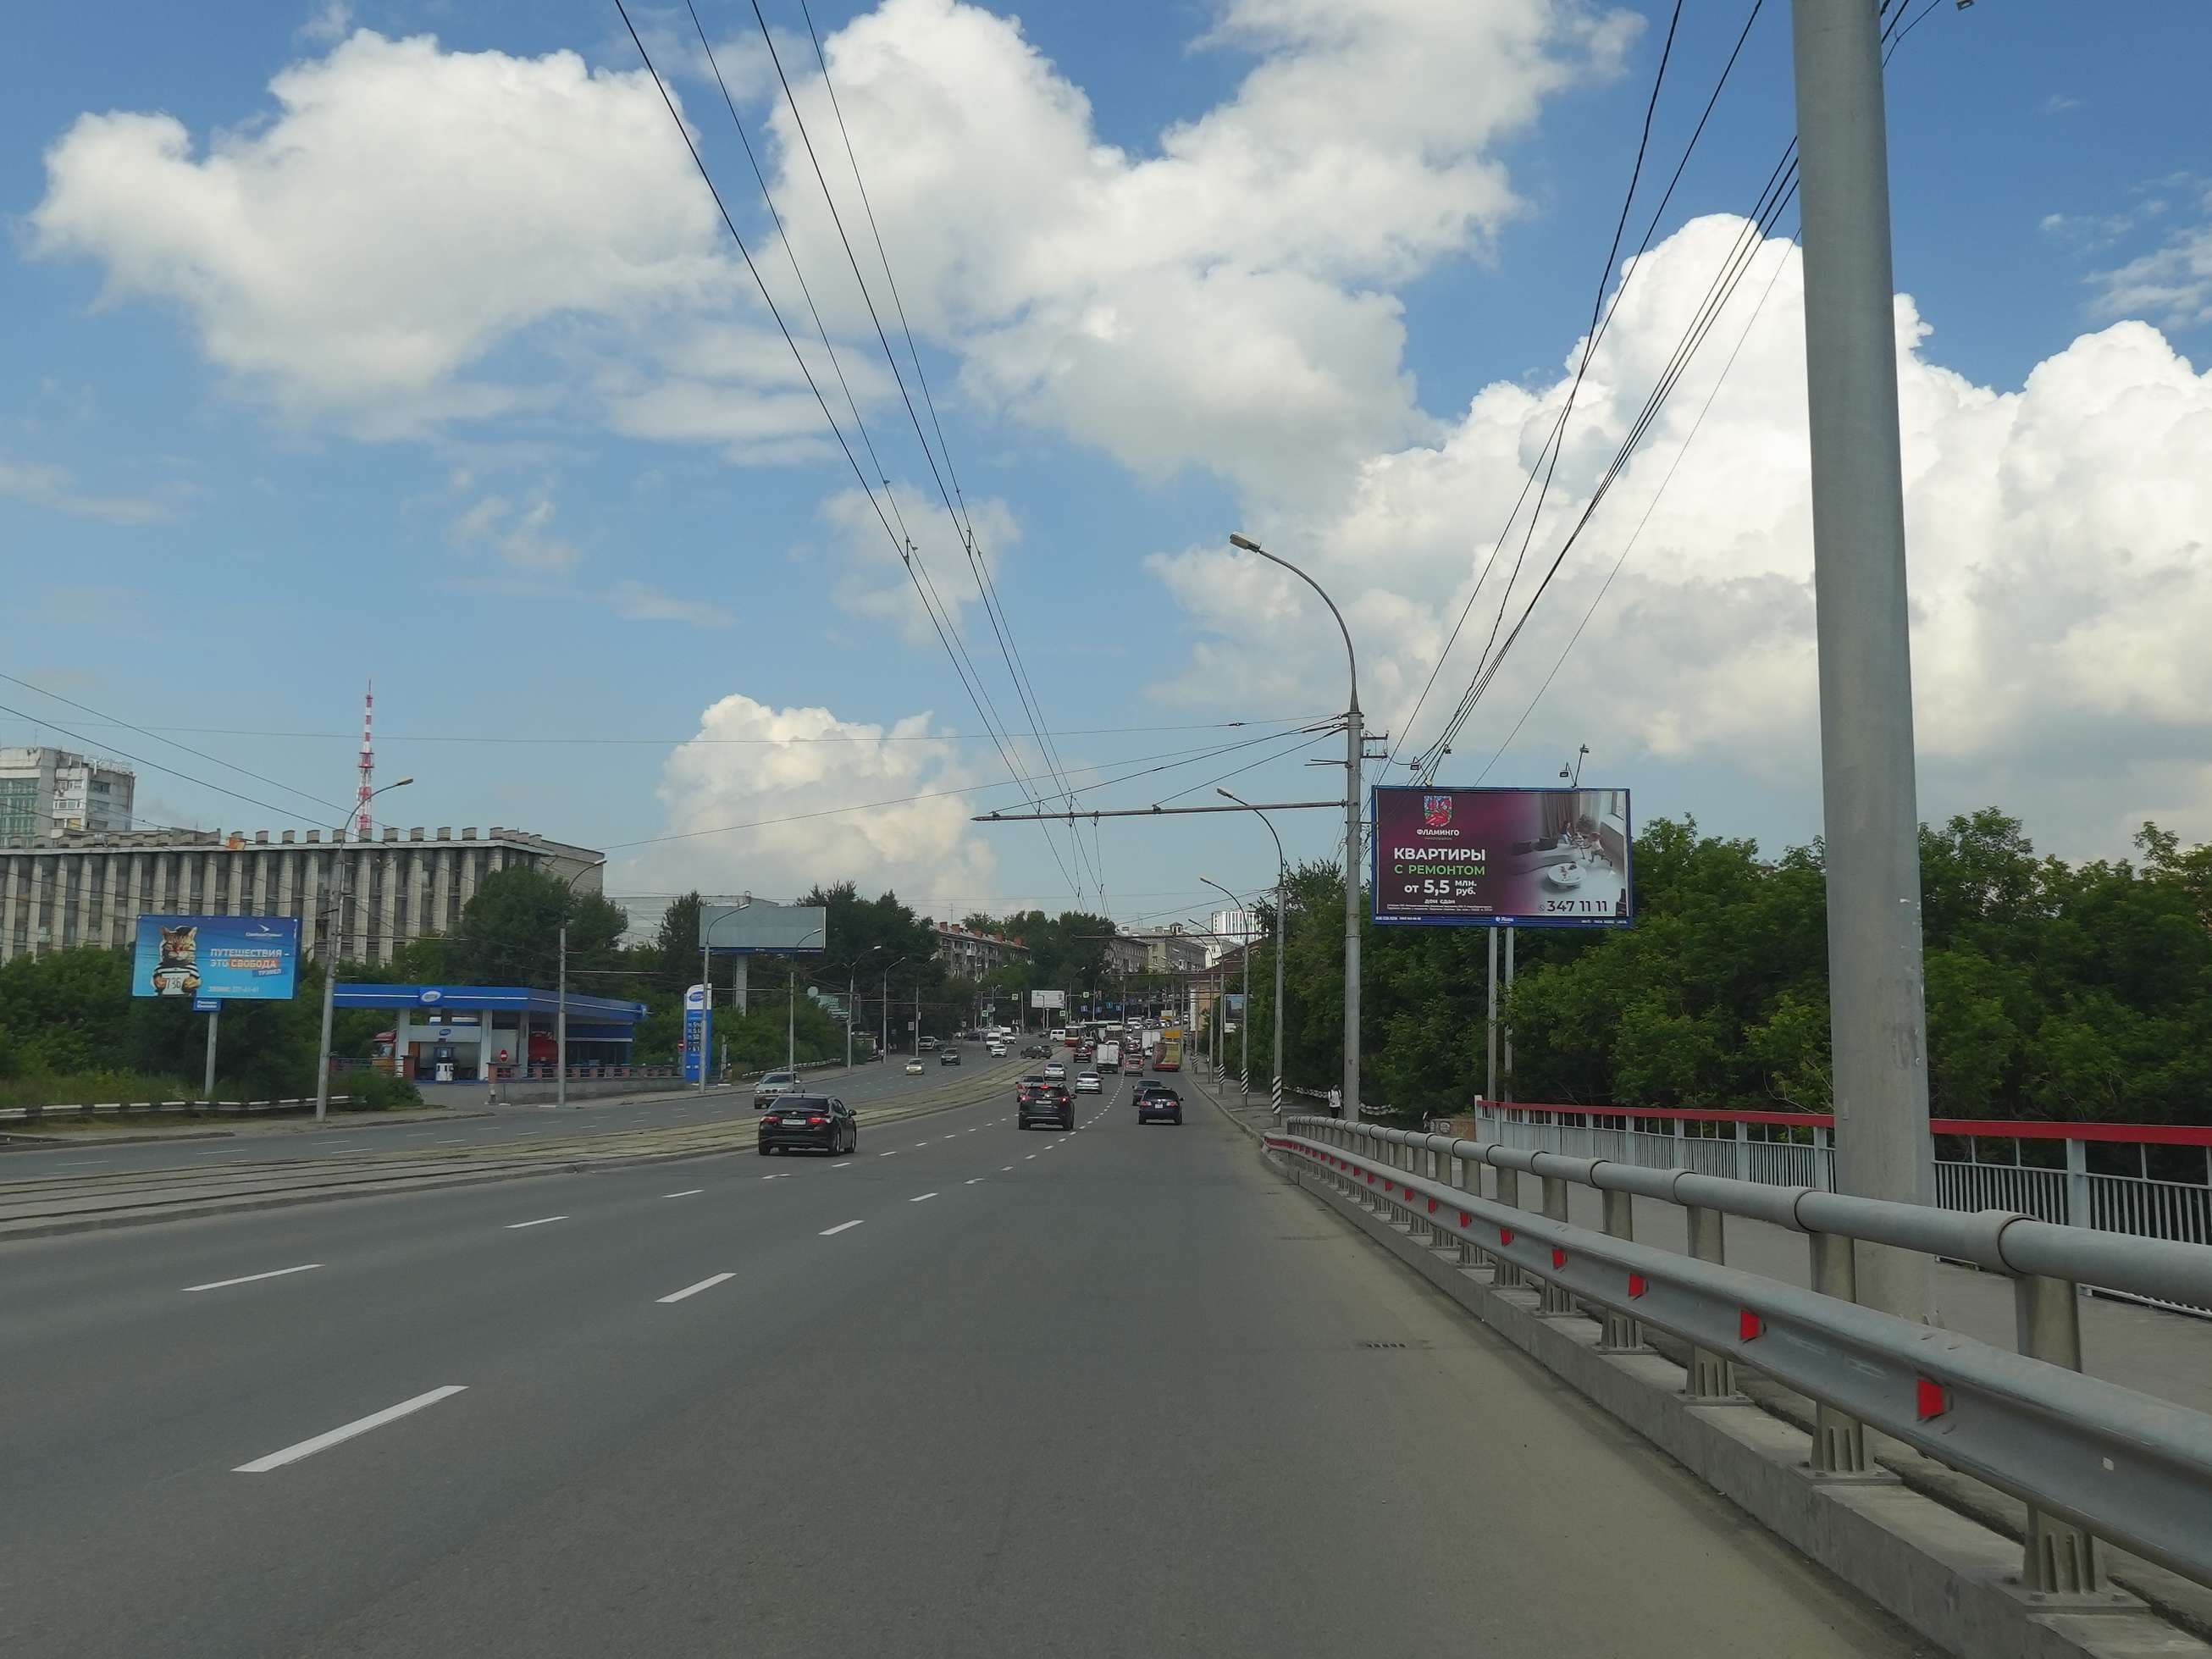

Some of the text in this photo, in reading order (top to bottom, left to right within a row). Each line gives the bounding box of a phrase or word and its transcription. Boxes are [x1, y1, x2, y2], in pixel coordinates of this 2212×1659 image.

[1416, 828, 1460, 837] ФЛАМИНГО
[1394, 848, 1485, 861] КВАРТИРЫ
[1394, 865, 1485, 876] С РЕМОНТОМ
[1404, 884, 1419, 893] от
[1424, 879, 1450, 896] 5,5
[1456, 887, 1476, 896] руб.
[1546, 900, 1607, 912] 347 11 11
[210, 948, 282, 958] ПУТЕШЕСТВИЯ
[210, 959, 277, 969] ЭТО СВОБОДА
